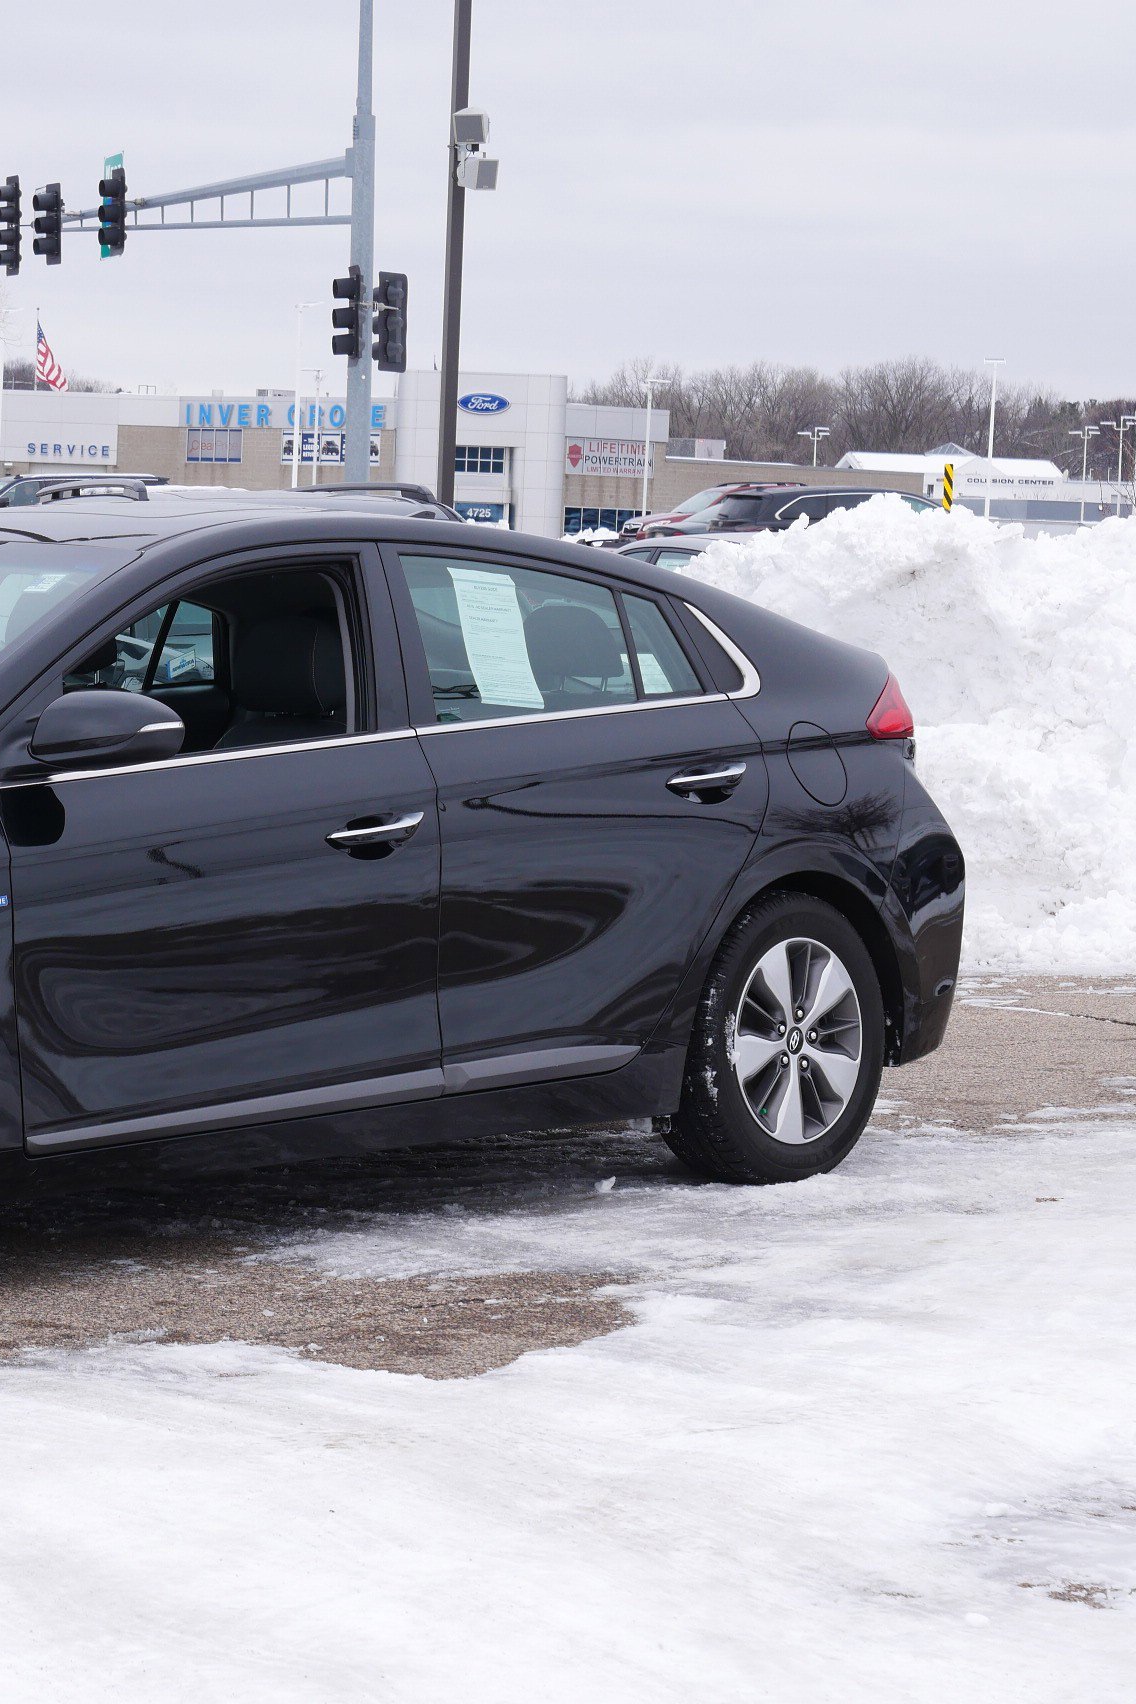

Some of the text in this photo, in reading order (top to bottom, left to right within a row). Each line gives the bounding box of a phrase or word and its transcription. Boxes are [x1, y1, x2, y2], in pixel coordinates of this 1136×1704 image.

[467, 396, 499, 410] Ford
[185, 403, 386, 429] INVER GROE
[27, 442, 110, 457] SERVICE
[589, 441, 647, 456] LIFETIME
[613, 467, 648, 475] WARRANT
[466, 507, 492, 518] 4725
